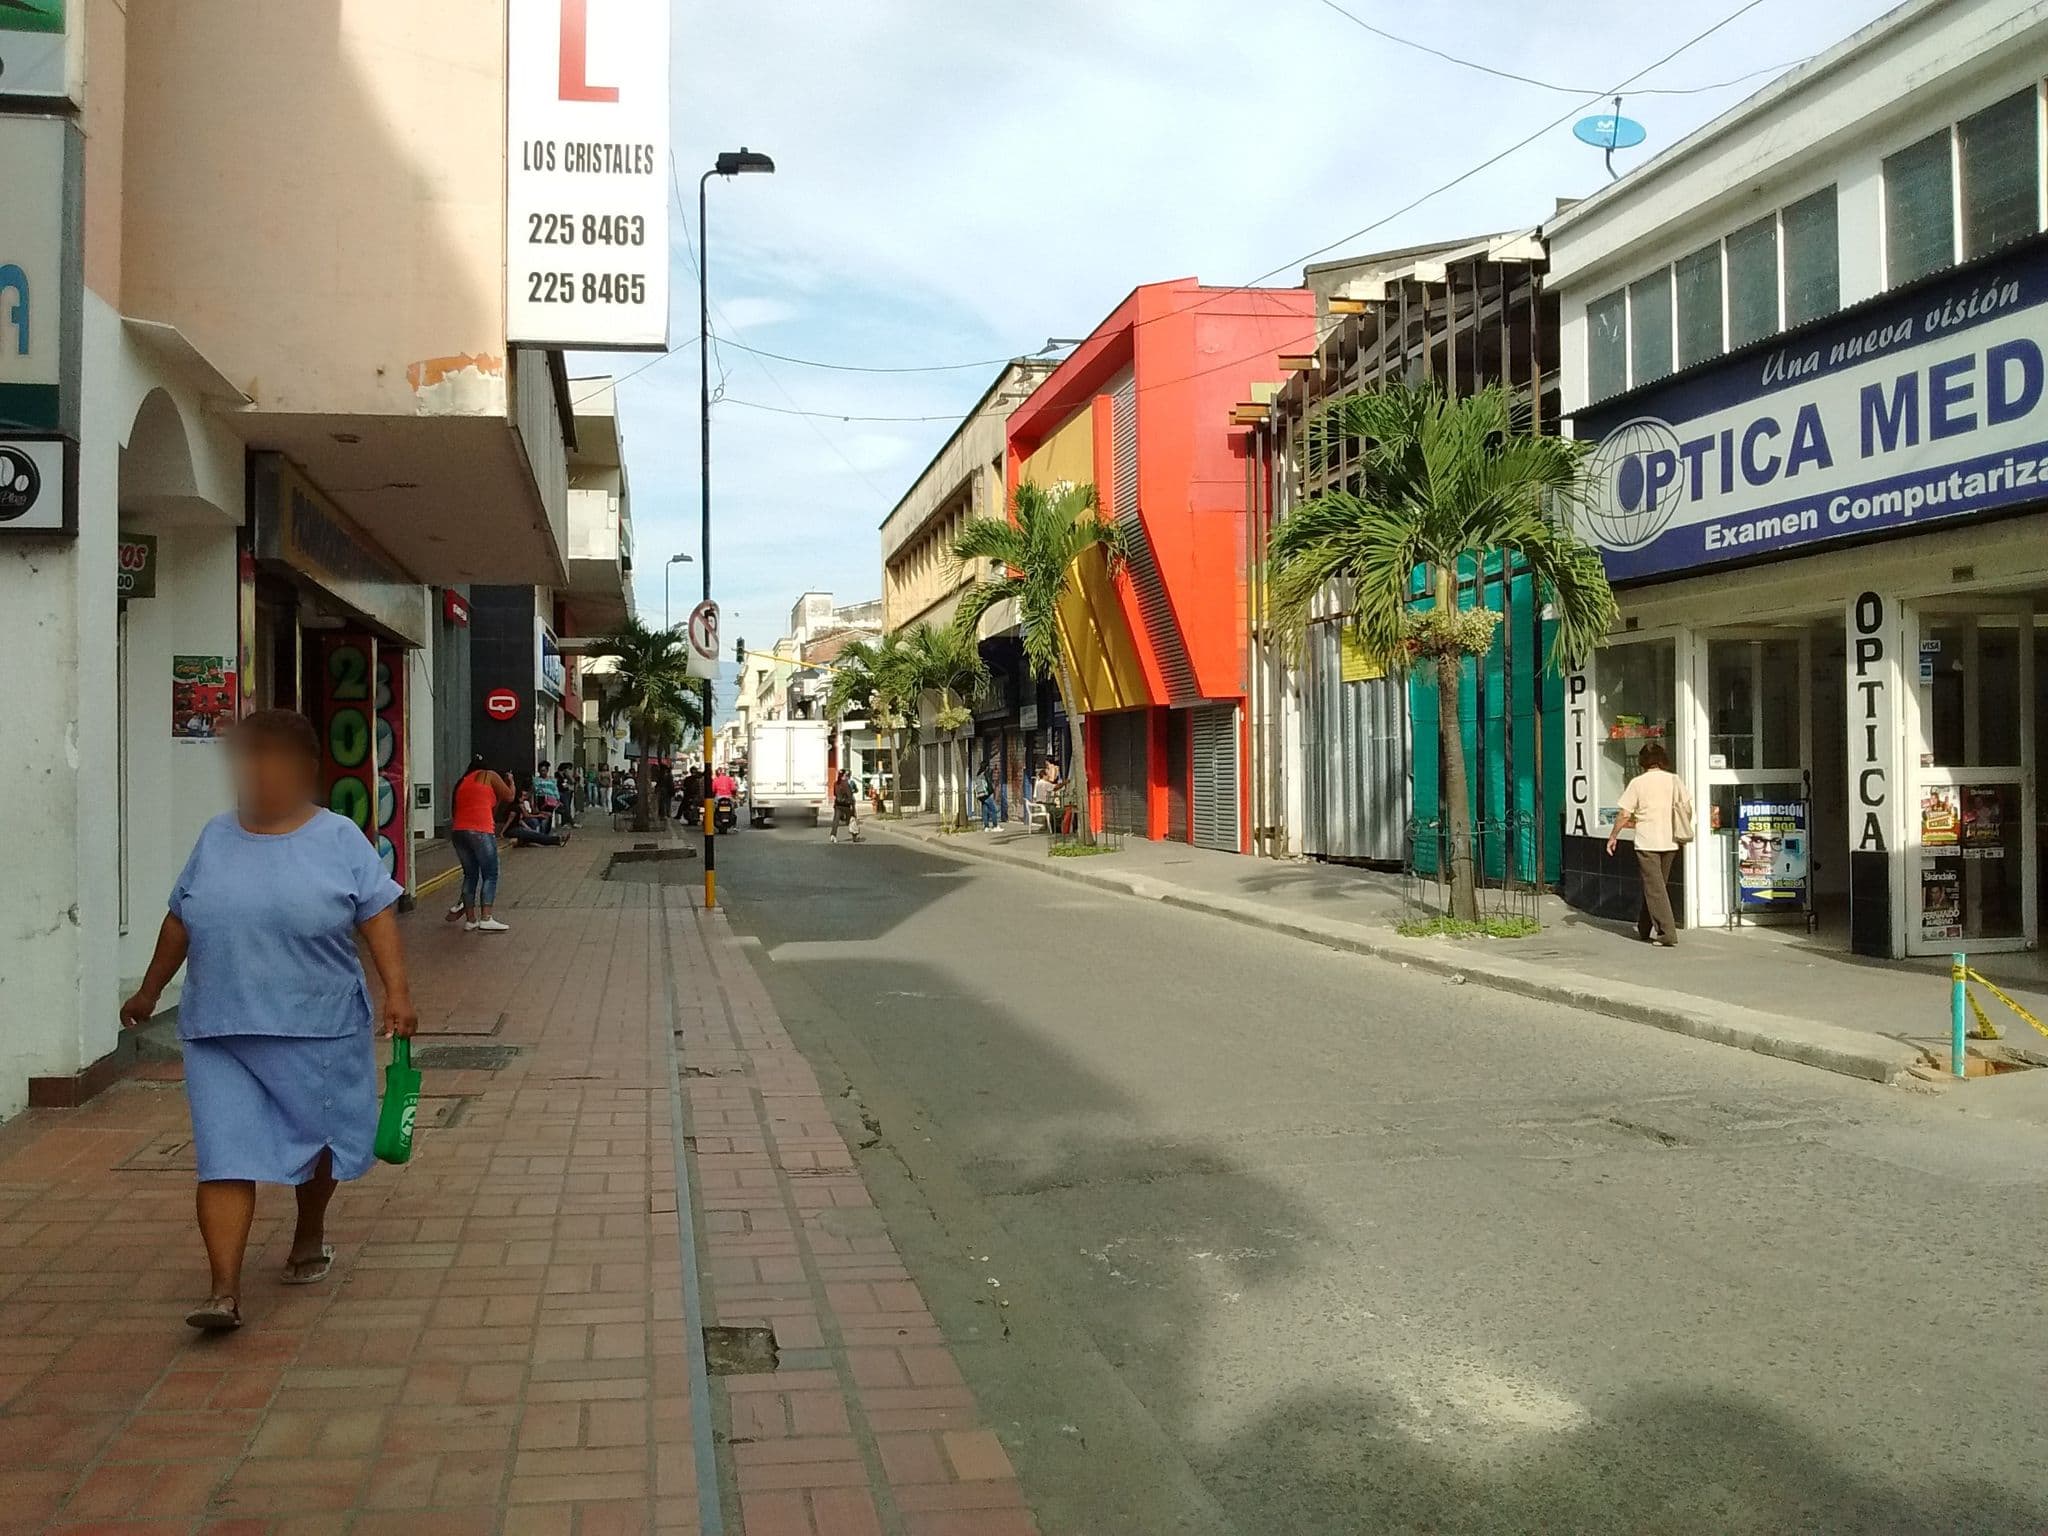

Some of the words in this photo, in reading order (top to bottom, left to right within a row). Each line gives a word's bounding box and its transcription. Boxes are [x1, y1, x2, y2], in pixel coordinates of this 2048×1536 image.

[524, 140, 556, 171] LOS
[565, 142, 653, 175] CRISTALES
[529, 213, 574, 245] 225
[582, 214, 645, 246] 8463
[528, 271, 574, 303] 225
[582, 272, 645, 304] 8465
[1762, 350, 1819, 386] Una
[1829, 317, 1914, 365] nueva
[1924, 276, 2019, 332] visión
[1618, 402, 1834, 514] OPTICA
[1860, 338, 2045, 459] MED
[1704, 509, 1818, 551] Examen
[1921, 641, 1940, 651] VISA
[1855, 591, 1886, 851] OPTICA
[1570, 655, 1588, 836] PTICA
[1740, 803, 1804, 818] PROMOCIÓN
